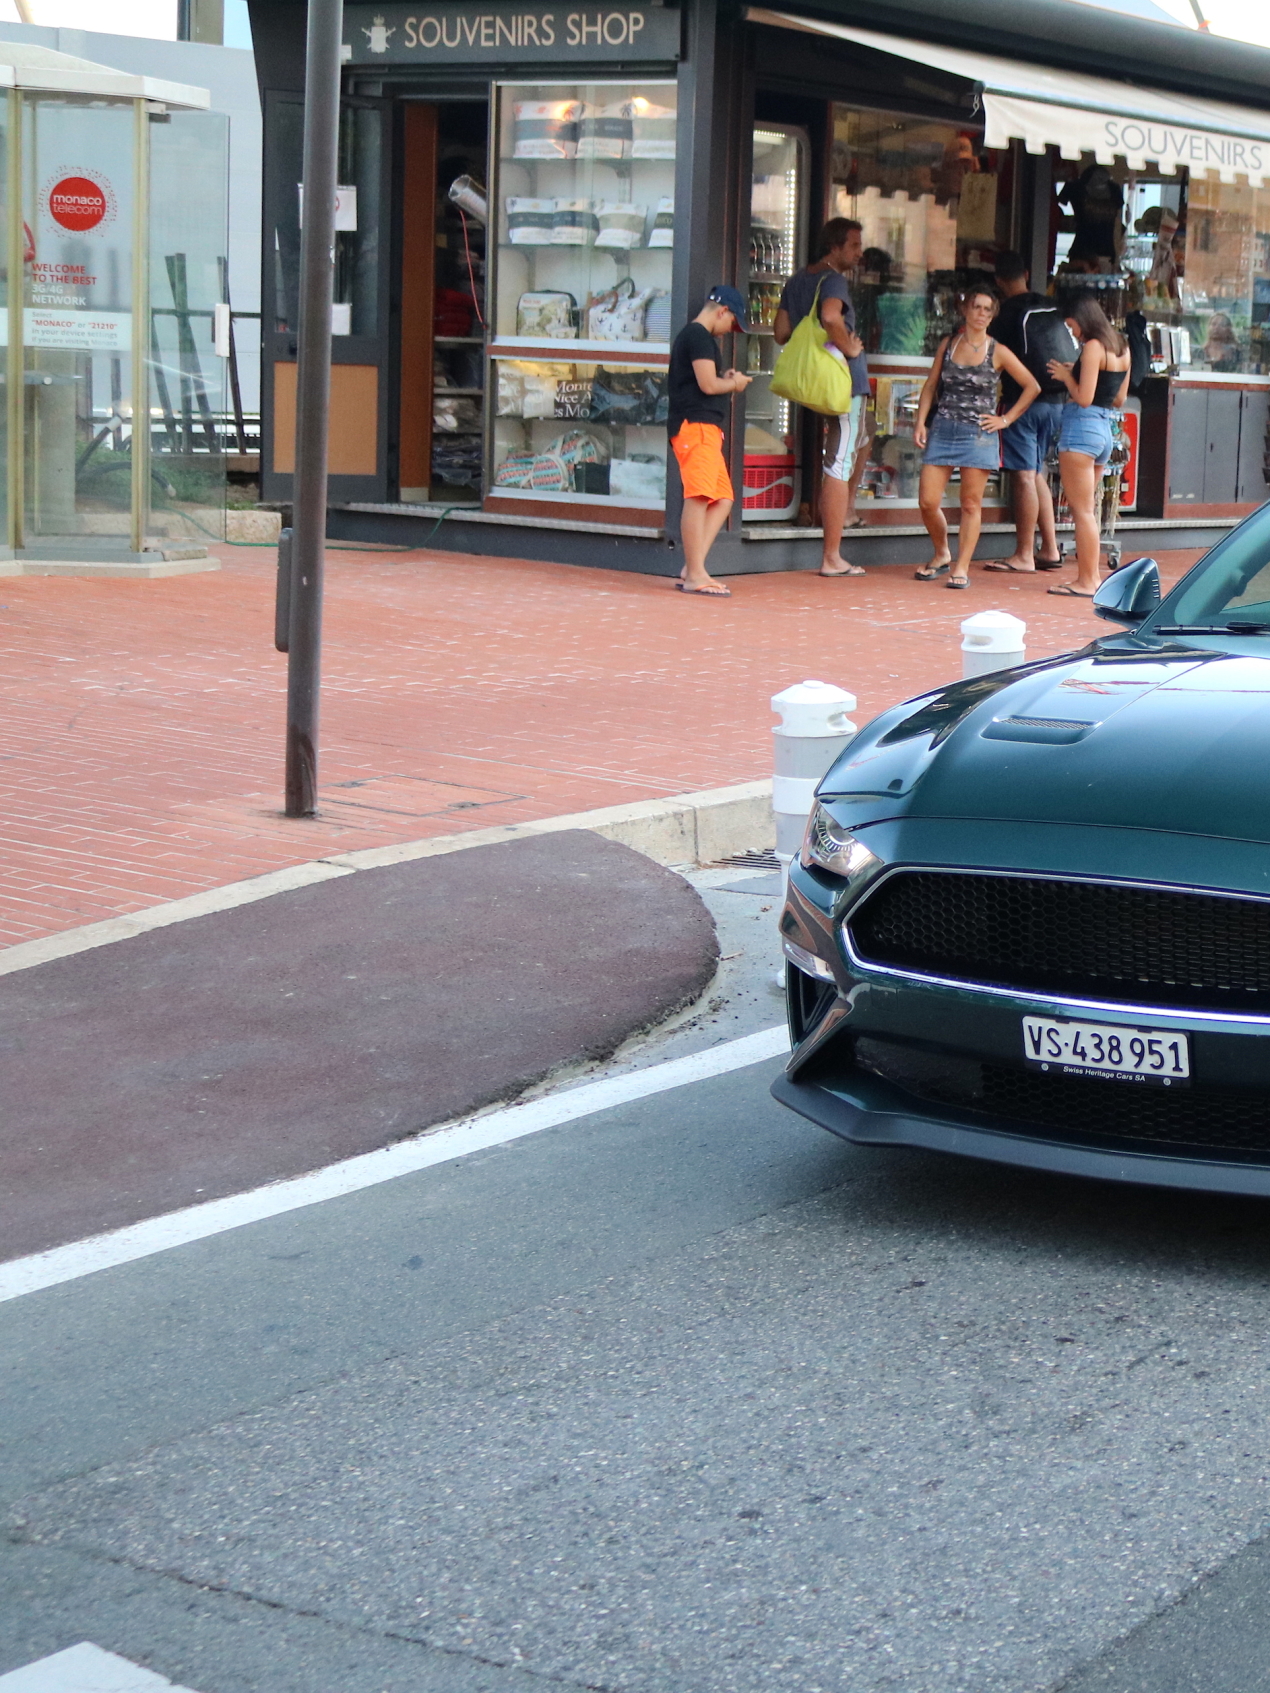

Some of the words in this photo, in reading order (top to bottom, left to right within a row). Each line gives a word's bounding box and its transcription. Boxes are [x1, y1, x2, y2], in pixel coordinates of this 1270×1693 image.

[404, 14, 555, 48] SOUVENIRS
[566, 12, 645, 46] SHOP
[1104, 121, 1262, 170] SOUVENIRS
[53, 195, 102, 206] monaco
[53, 203, 103, 215] telecom
[31, 263, 86, 274] WELCOME
[32, 273, 47, 283] TO
[49, 274, 70, 284] THE
[72, 276, 97, 285] BEST
[32, 284, 64, 294] 3G/4G
[32, 294, 86, 306] NETWORK
[41, 329, 59, 337] your
[87, 331, 118, 340] settings
[65, 339, 90, 347] visiting
[1063, 1065, 1084, 1075] Swiss
[1085, 1068, 1115, 1079] Heritage
[1116, 1072, 1133, 1080] Cars
